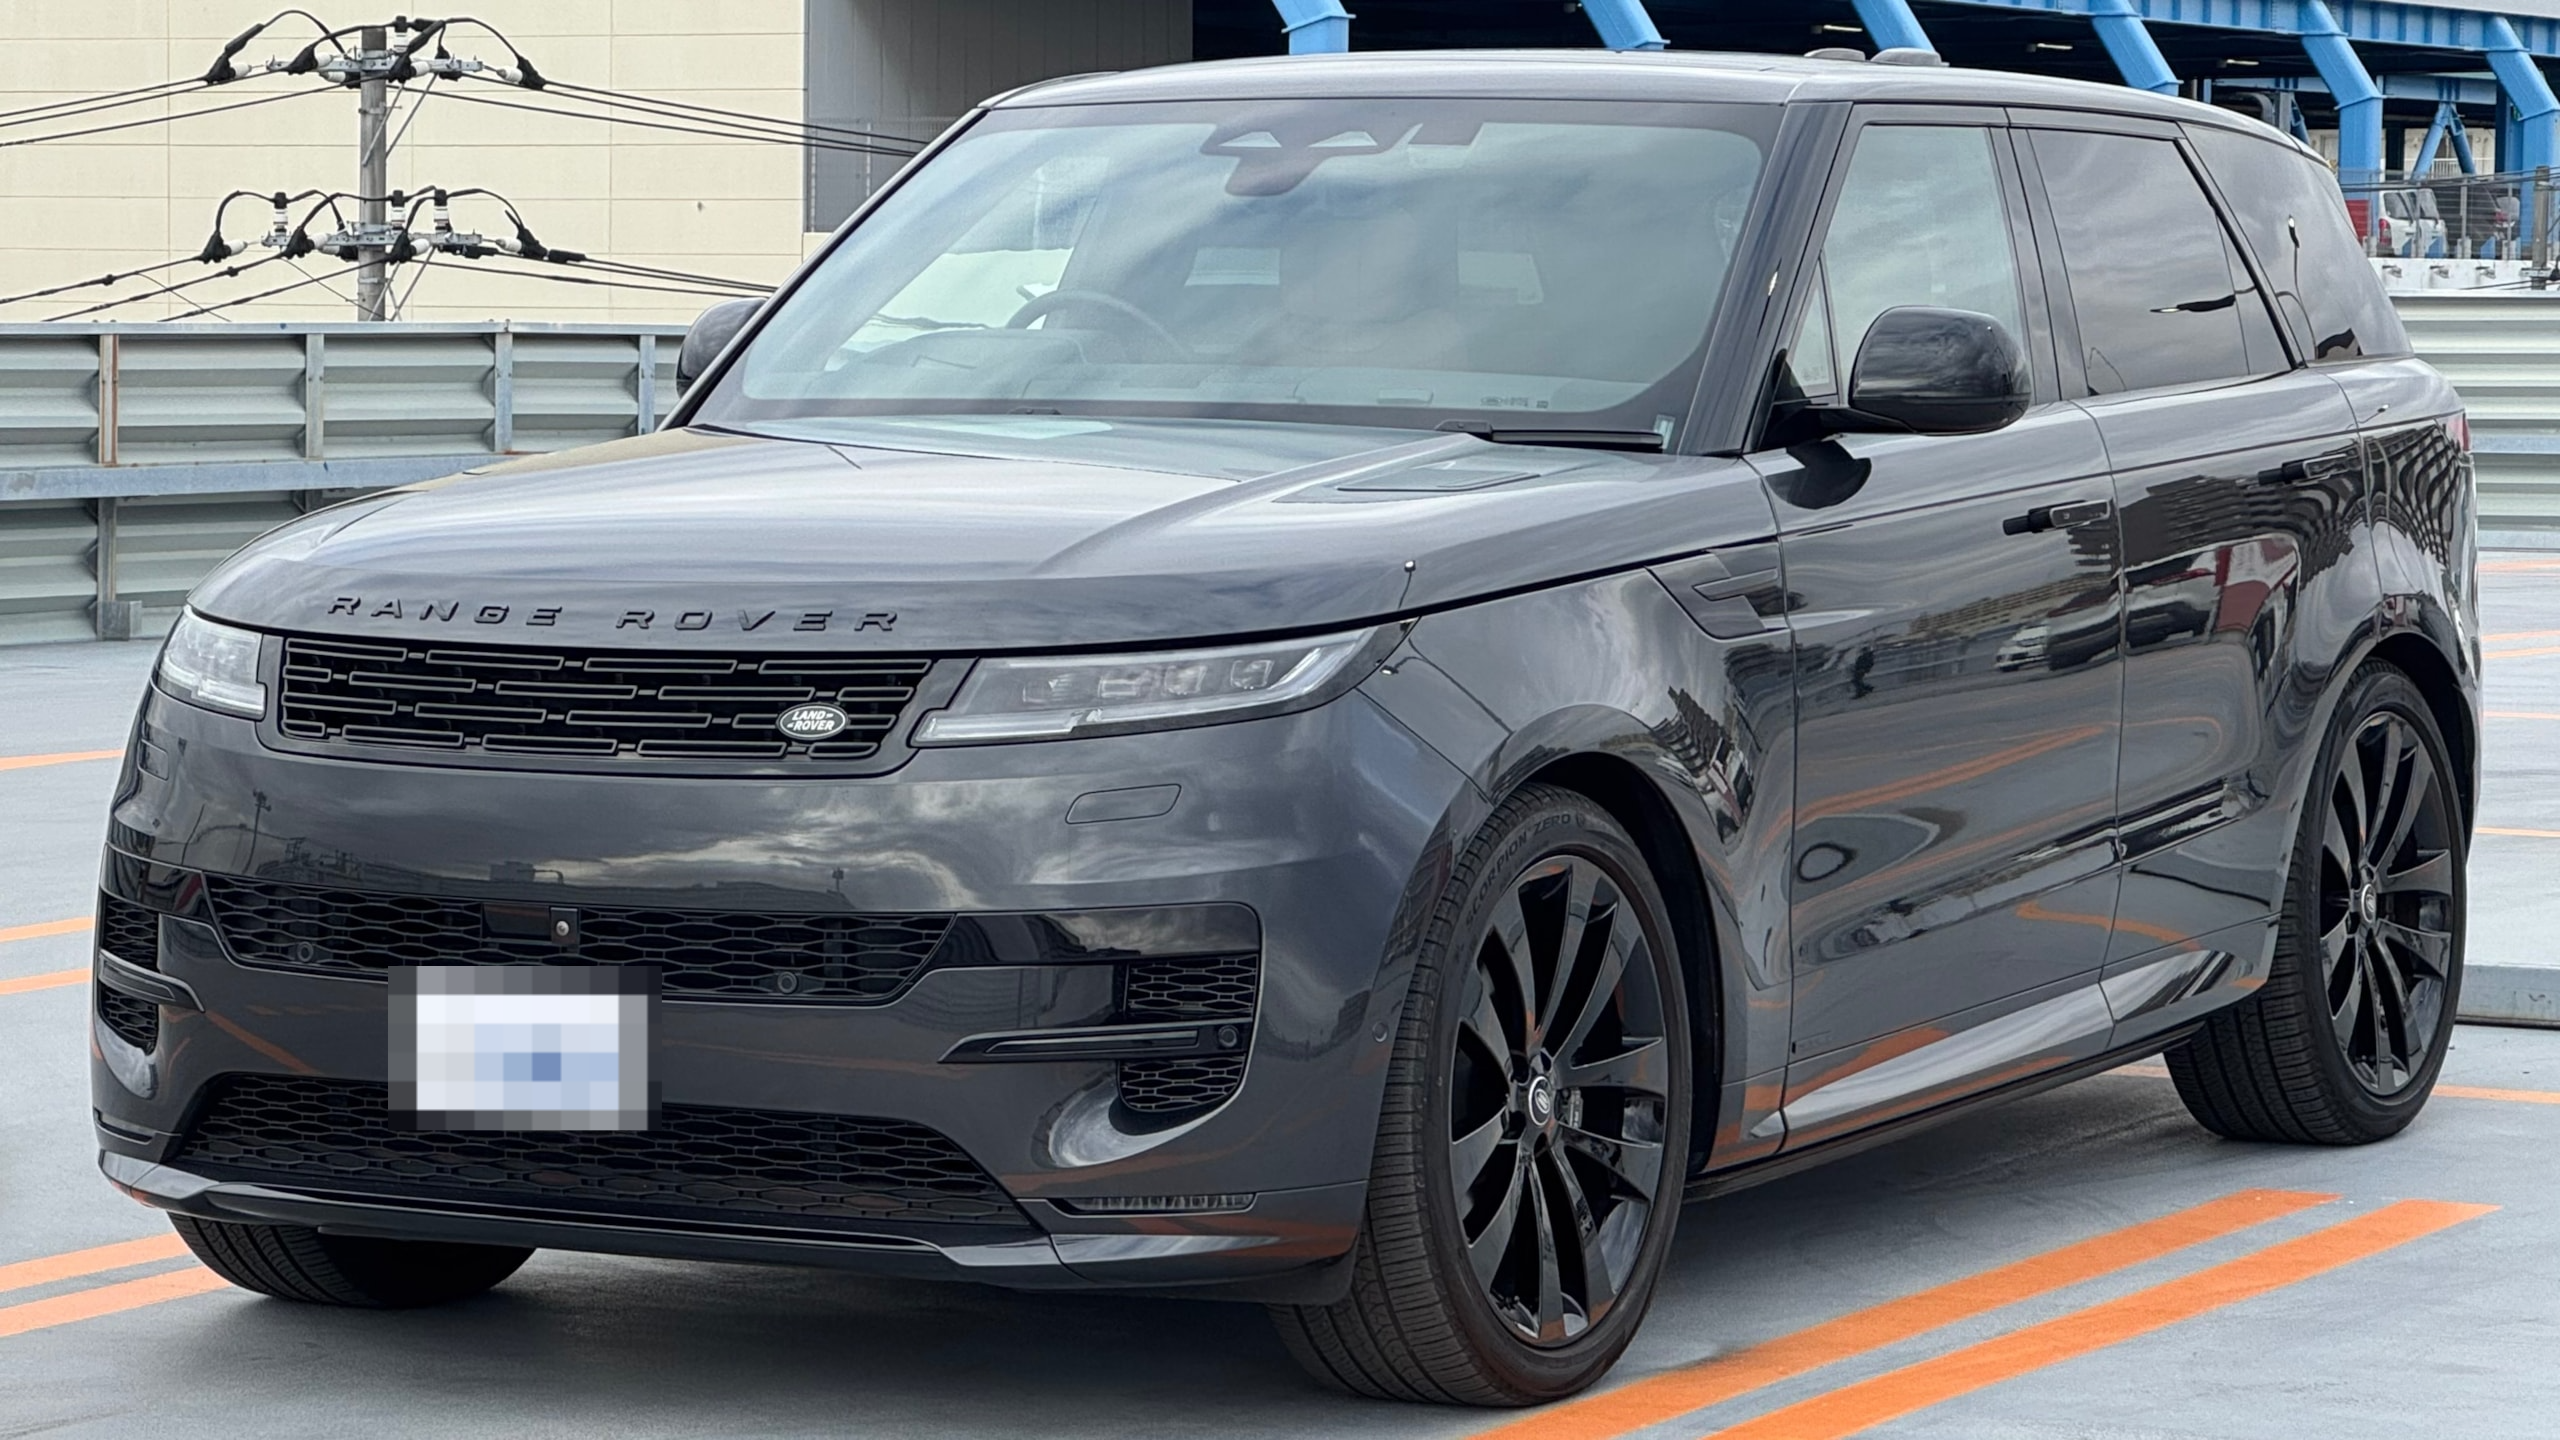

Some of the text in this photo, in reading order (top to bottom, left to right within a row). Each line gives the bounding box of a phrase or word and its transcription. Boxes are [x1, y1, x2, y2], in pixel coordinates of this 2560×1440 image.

[328, 596, 899, 632] RANGE ROVER
[1465, 813, 1571, 926] SCORPION ZERO
